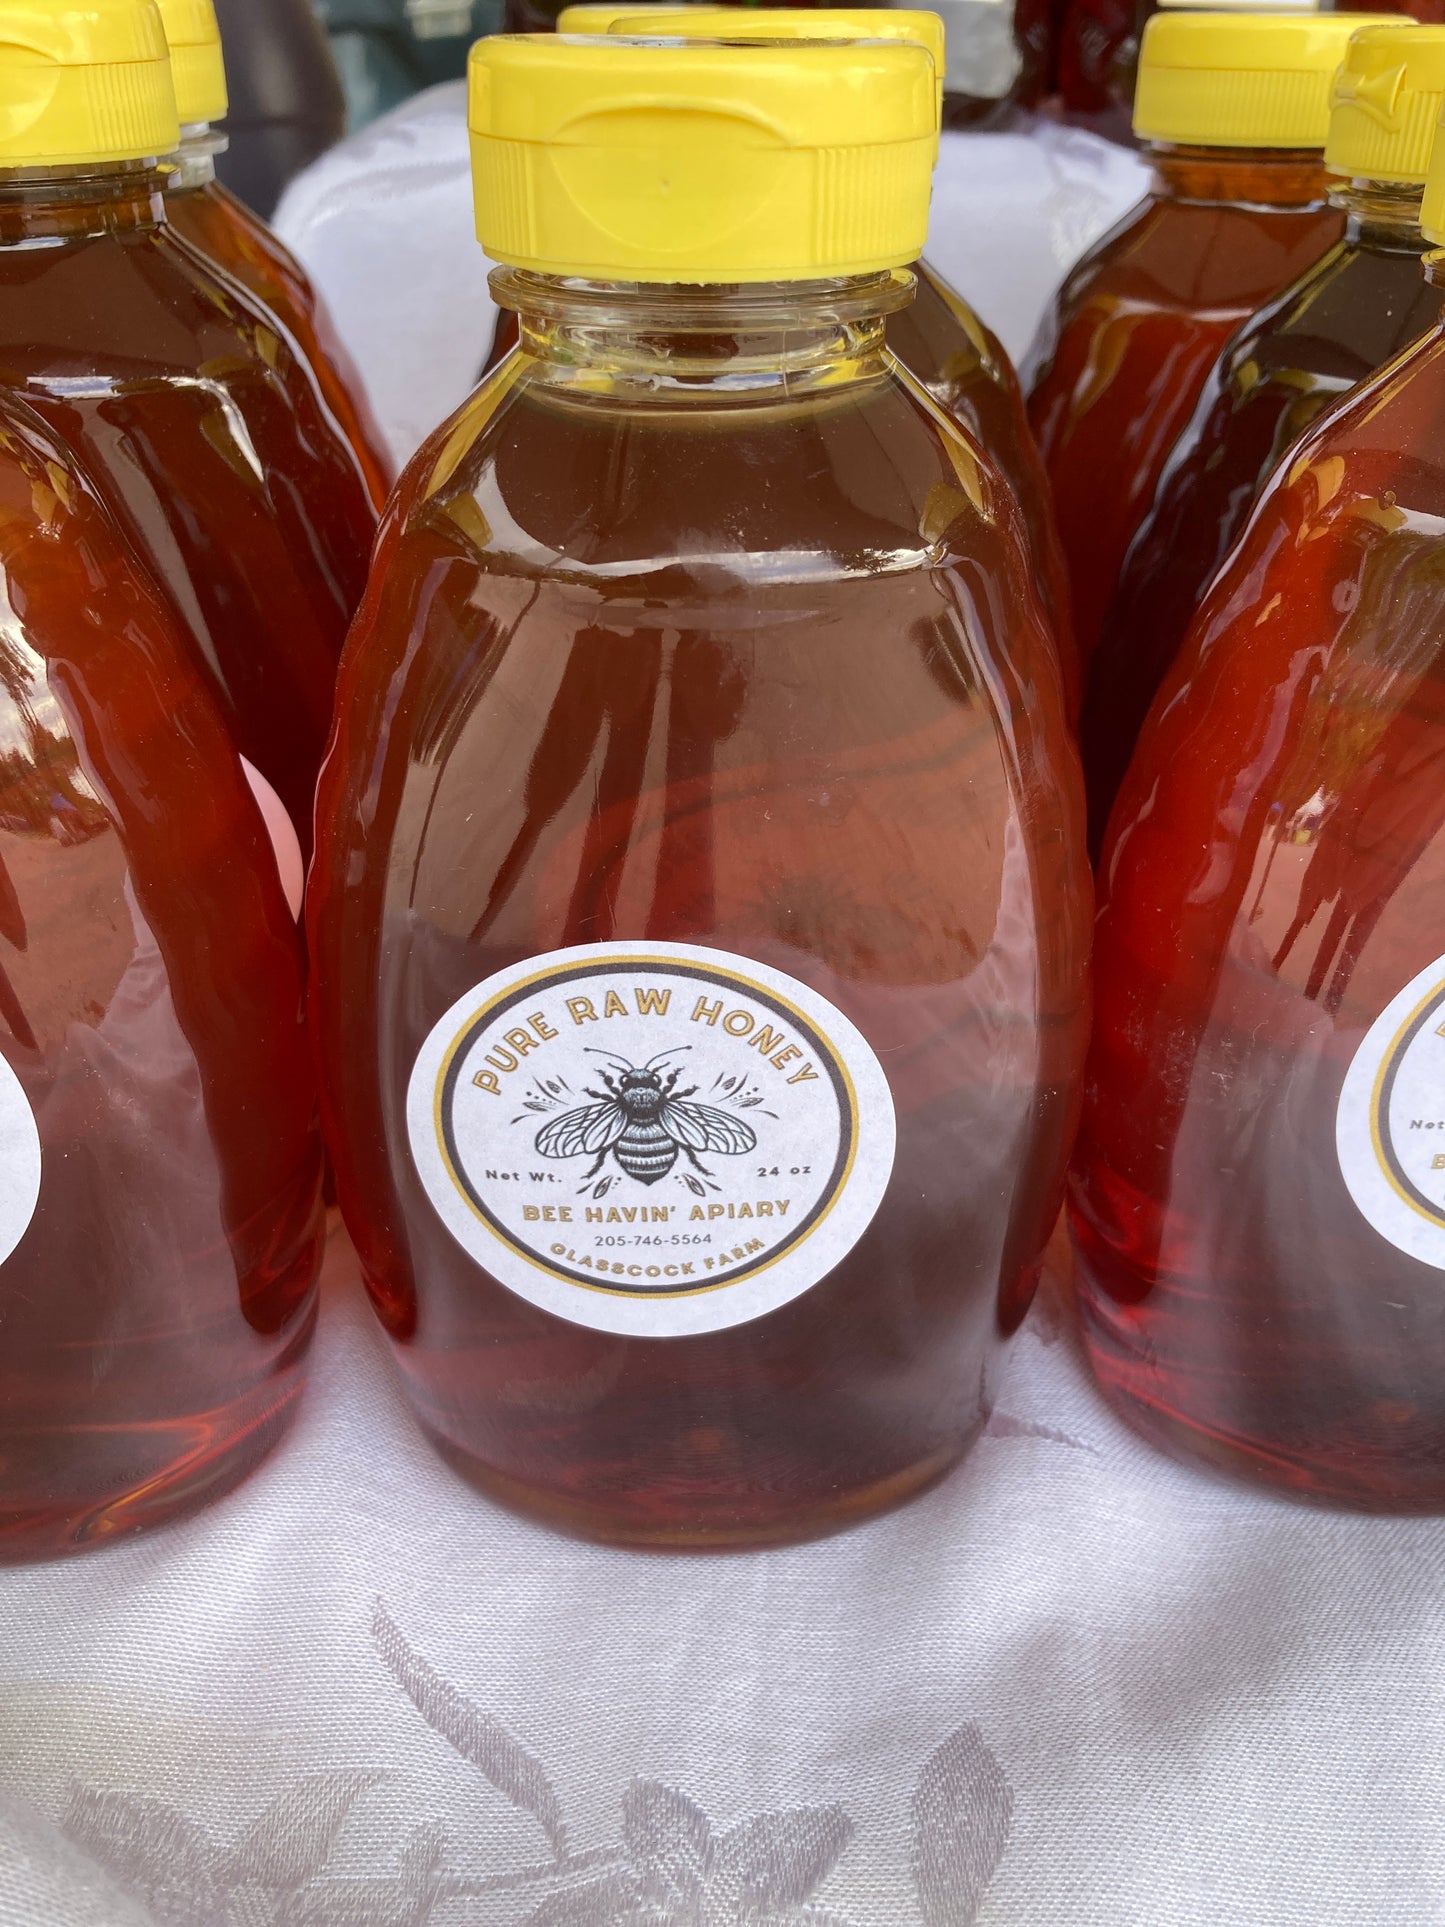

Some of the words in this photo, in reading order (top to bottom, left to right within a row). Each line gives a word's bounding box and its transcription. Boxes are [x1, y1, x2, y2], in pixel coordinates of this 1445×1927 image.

[472, 1011, 558, 1096] PURE
[565, 988, 672, 1025] RAW
[690, 996, 819, 1087] HONEY
[485, 1169, 520, 1181] Net
[529, 1171, 562, 1183] Wt.
[756, 1166, 780, 1177] 24
[790, 1165, 812, 1175] oz
[523, 1204, 573, 1222] BEE
[585, 1205, 676, 1223] HAVIN'
[689, 1199, 791, 1221] APIARY
[594, 1233, 712, 1247] 205-746-5564
[550, 1242, 695, 1278] GLASSCOCK
[703, 1237, 765, 1270] FARM
